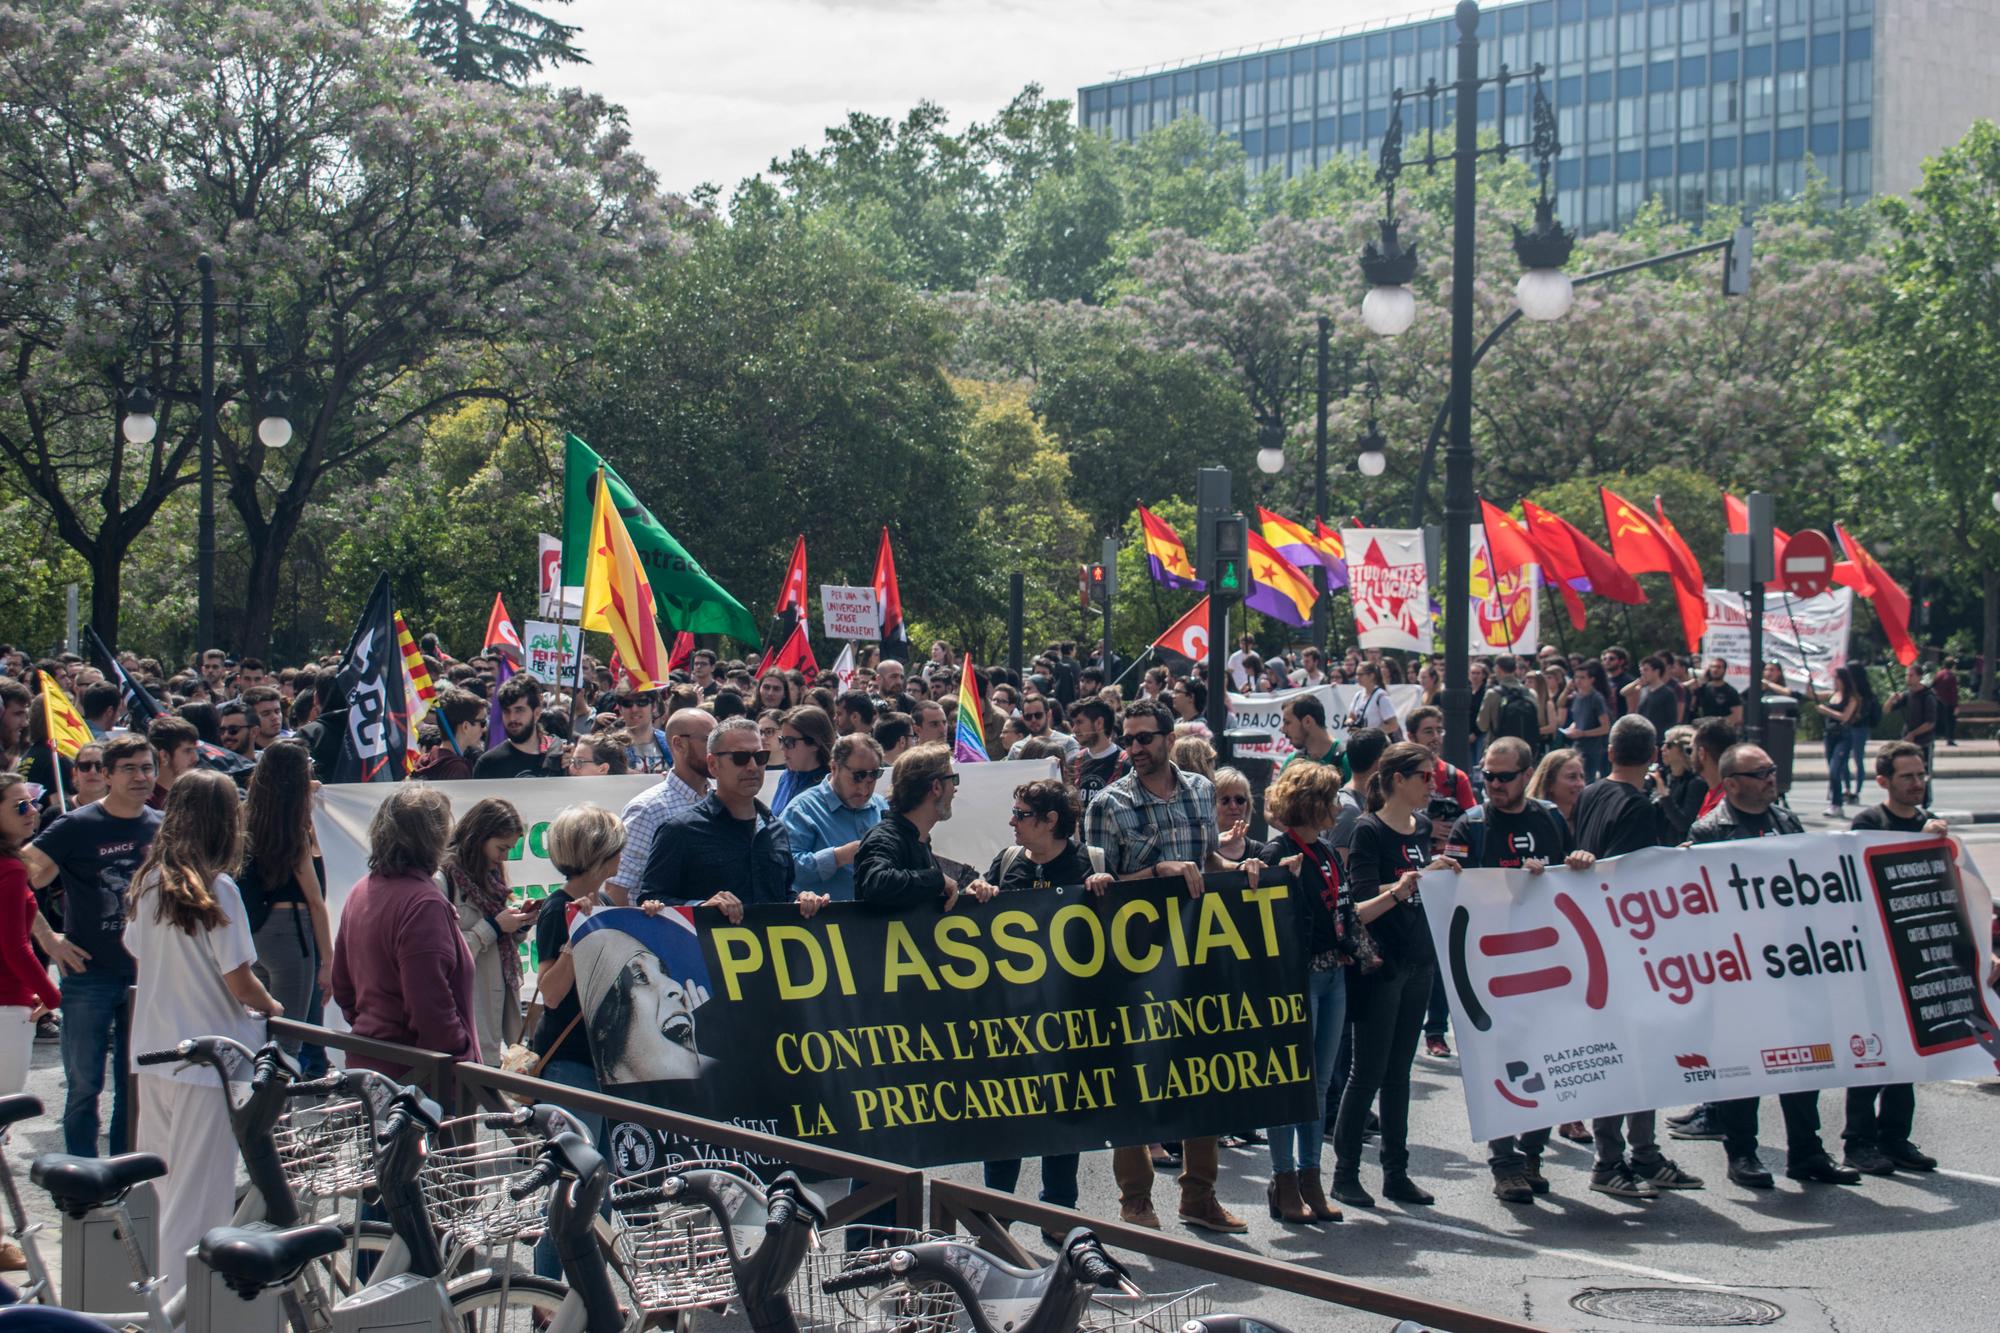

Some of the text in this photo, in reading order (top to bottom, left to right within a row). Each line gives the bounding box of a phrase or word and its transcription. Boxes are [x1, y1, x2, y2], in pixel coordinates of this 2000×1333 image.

[831, 590, 857, 601] PER UNA
[1374, 580, 1418, 599] LUCHA
[826, 602, 871, 614] UNIVERSITAT
[835, 613, 857, 623] SENSE
[100, 843, 135, 856] DANCE
[1600, 855, 1864, 941] igual treball
[711, 885, 1289, 1001] PDI ASSOCIAT
[1638, 925, 1868, 1005] igual salari
[775, 1024, 950, 1076] CONTRA
[1271, 995, 1307, 1027] DE
[1543, 1041, 1617, 1065] PLATAFORMA
[1761, 1046, 1814, 1067] CCOO
[1548, 1054, 1625, 1077] PROFESSORAT
[1683, 1068, 1717, 1083] STEPV
[1553, 1070, 1607, 1089] ASSOCIAT
[791, 1043, 1311, 1139] LA PRECARIETAT LABORAL
[1556, 1090, 1578, 1103] UPV
